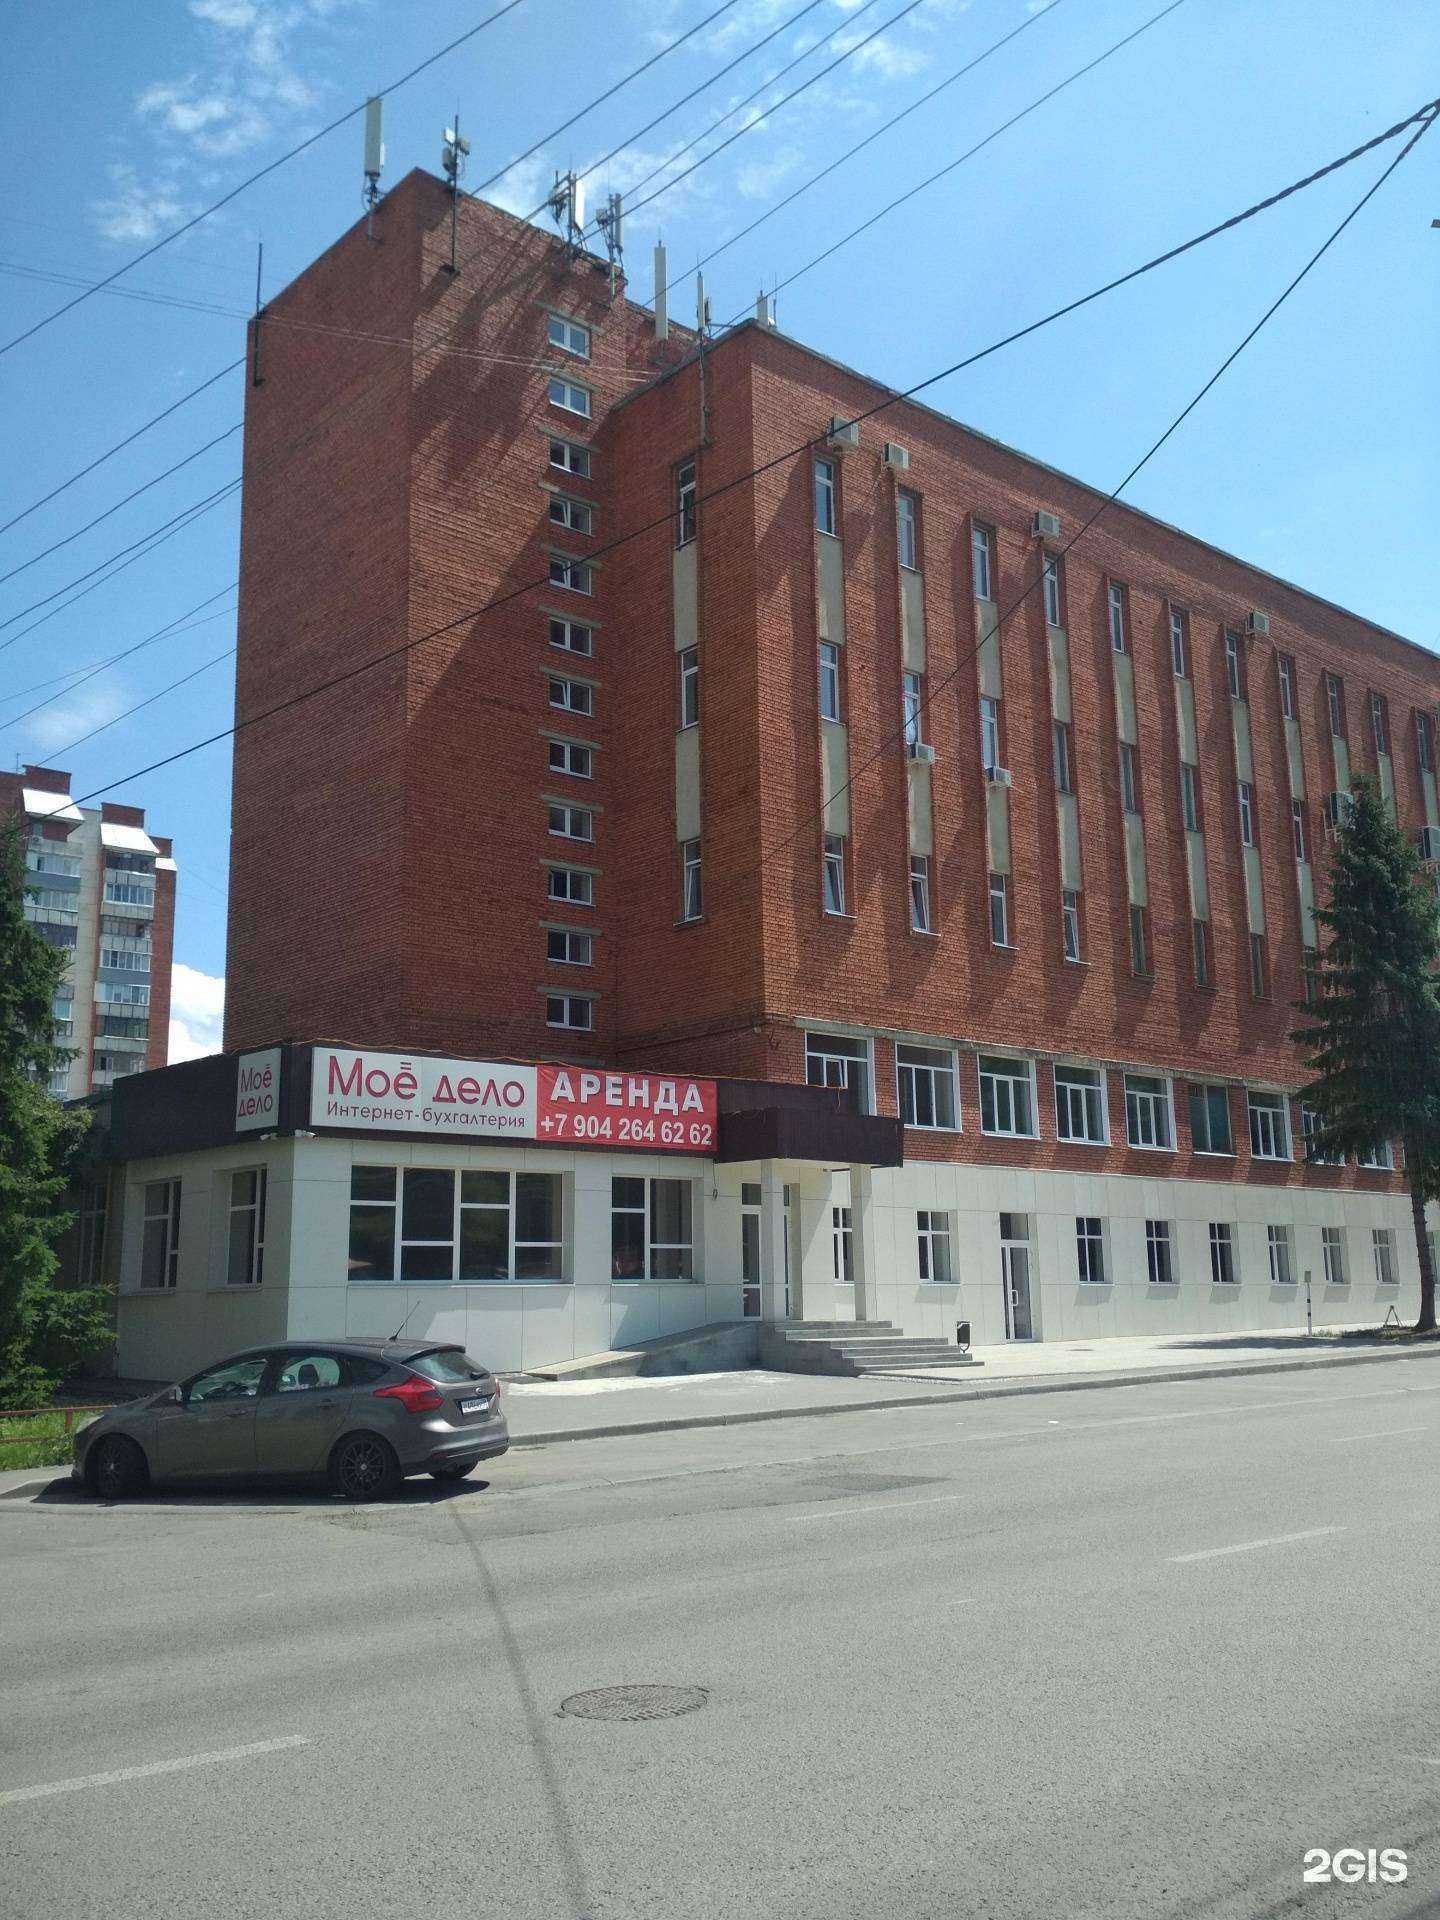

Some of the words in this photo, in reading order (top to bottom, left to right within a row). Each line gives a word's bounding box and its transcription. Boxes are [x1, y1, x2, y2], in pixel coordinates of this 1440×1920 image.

[240, 1064, 272, 1092] Моё
[328, 1056, 418, 1101] Моё
[432, 1075, 525, 1107] дело
[238, 1095, 273, 1117] дело
[550, 1072, 705, 1115] АРЕНДА
[327, 1101, 526, 1128] Интернет-бухгалтерия
[540, 1113, 568, 1136] +7
[574, 1114, 613, 1139] 904
[618, 1117, 655, 1142] 264
[660, 1120, 685, 1144] 62
[689, 1122, 713, 1146] 62
